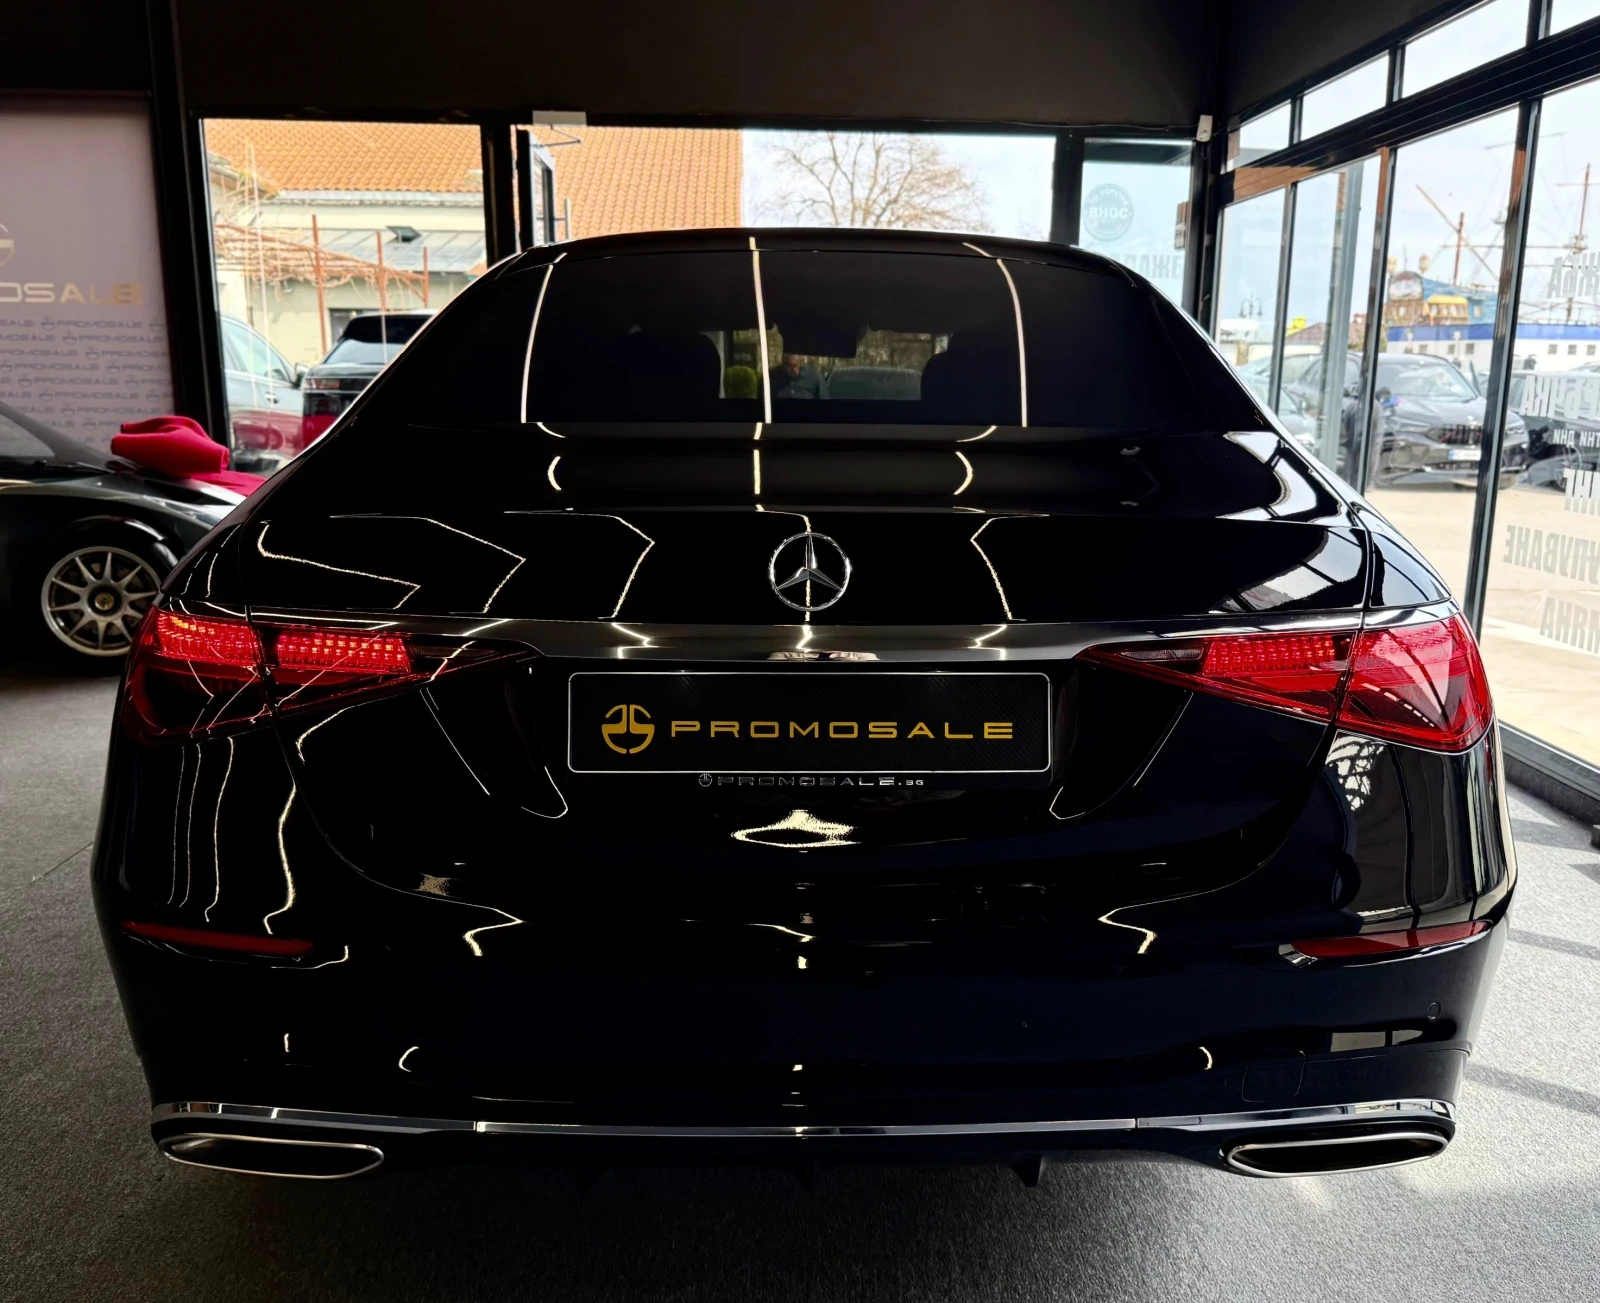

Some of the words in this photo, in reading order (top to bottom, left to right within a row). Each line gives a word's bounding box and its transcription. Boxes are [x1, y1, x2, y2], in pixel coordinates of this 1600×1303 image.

[1088, 206, 1129, 220] ВНОС
[1109, 253, 1184, 280] ДАЖБ
[671, 720, 1013, 740] PROMOSALE
[717, 775, 924, 786] PROMOSALE.BG
